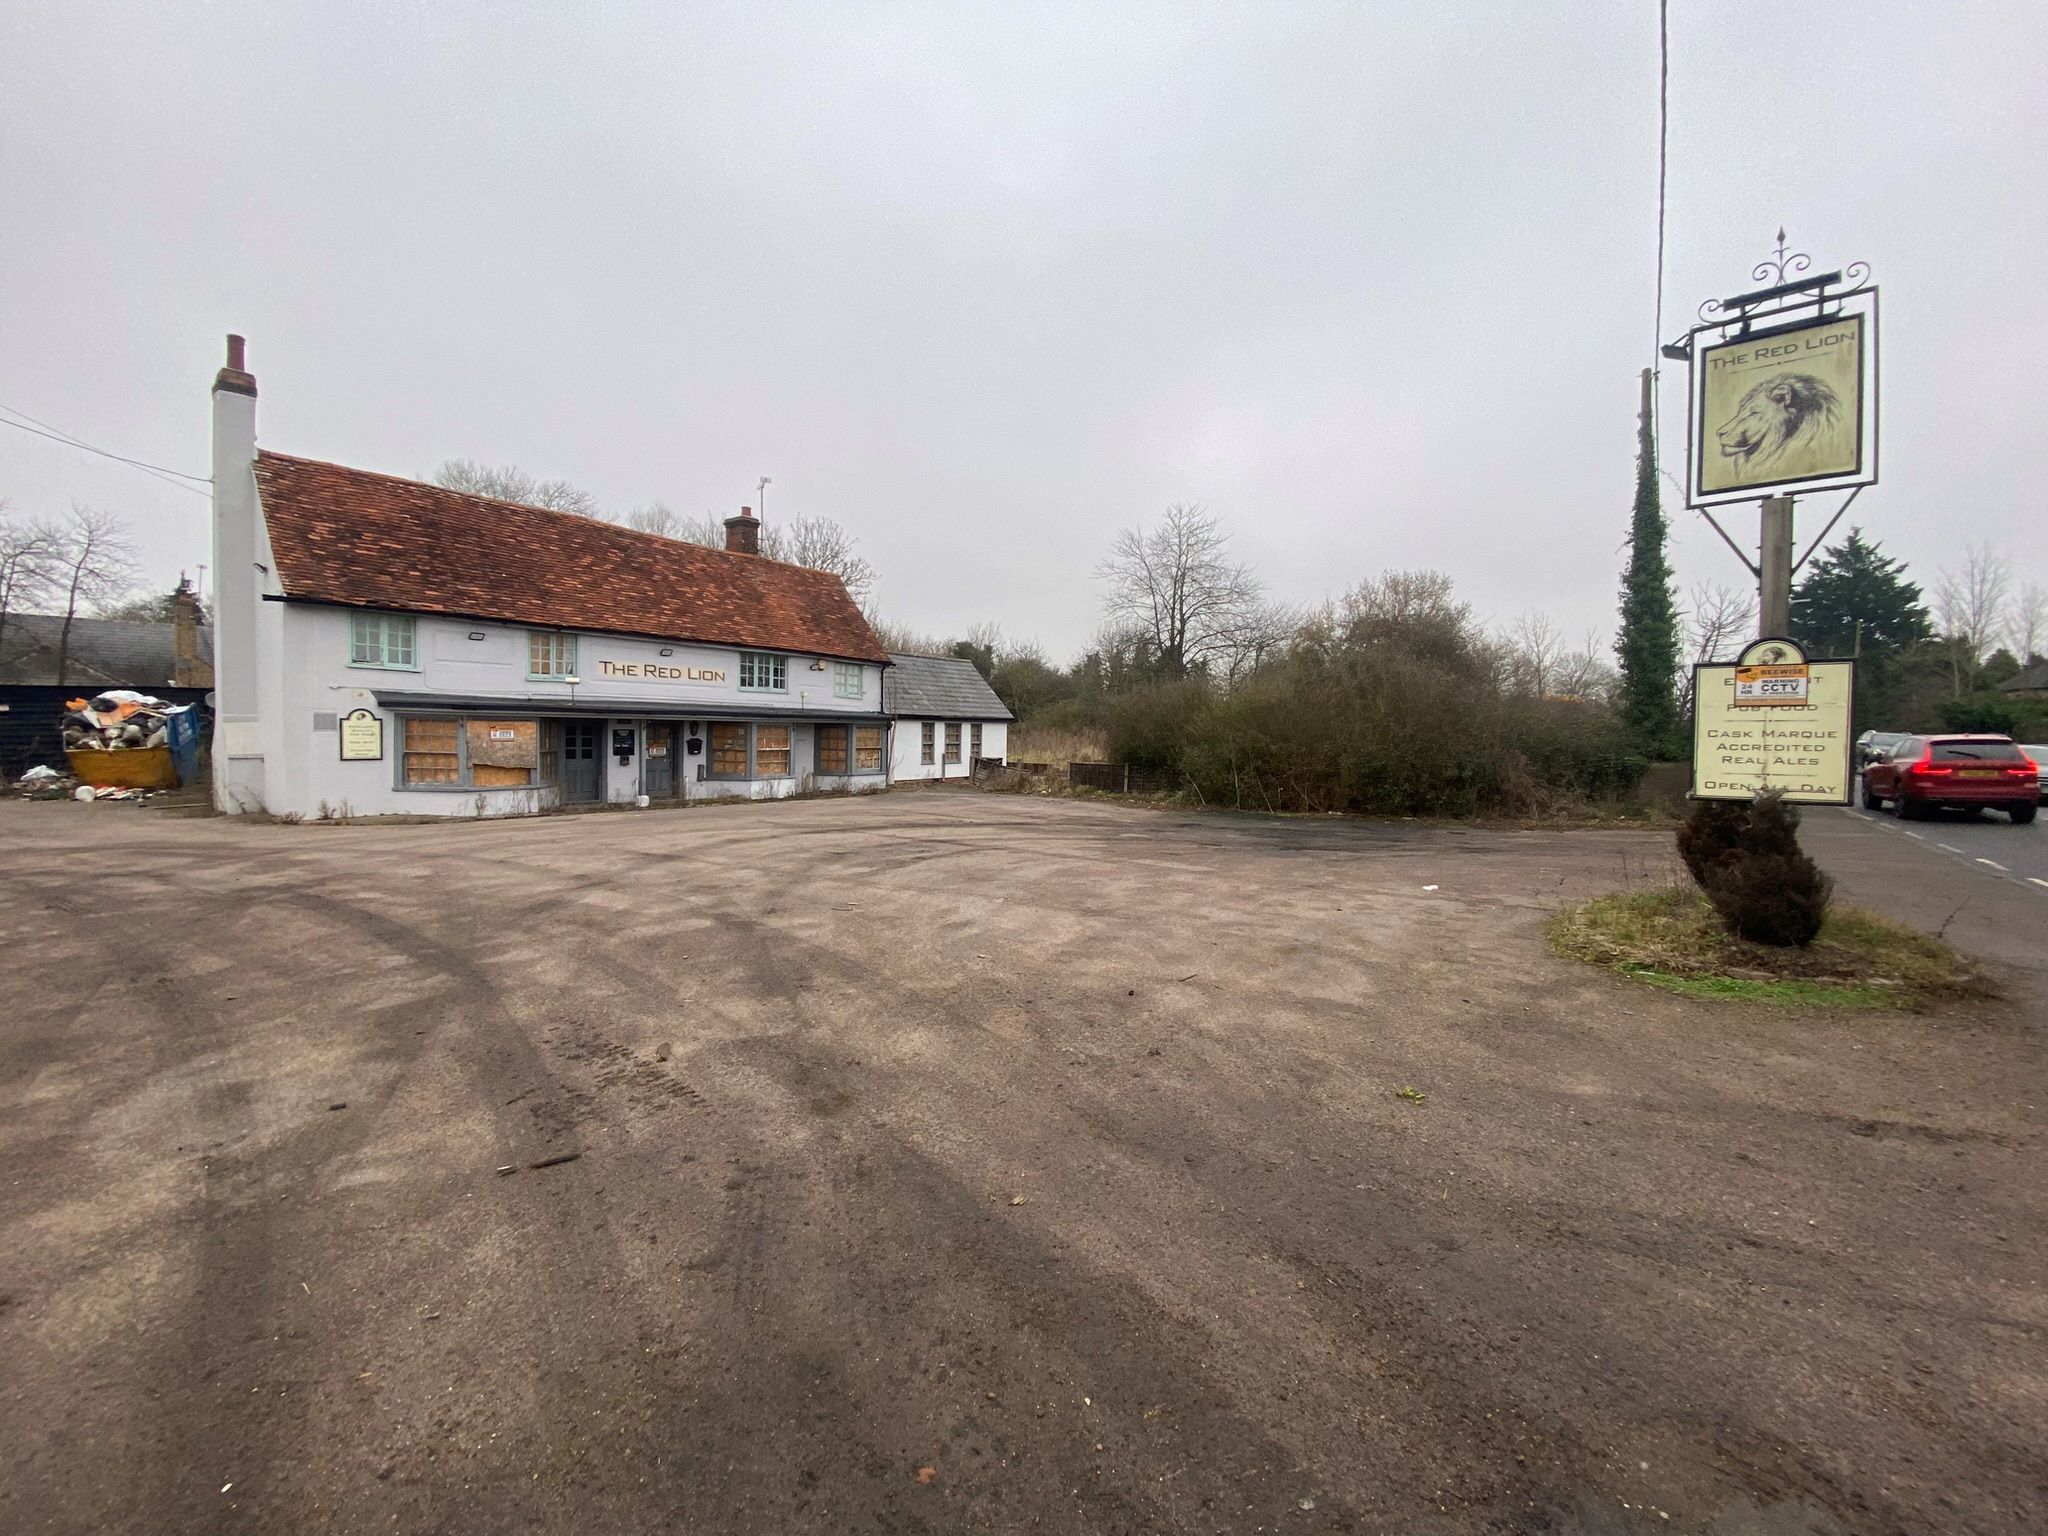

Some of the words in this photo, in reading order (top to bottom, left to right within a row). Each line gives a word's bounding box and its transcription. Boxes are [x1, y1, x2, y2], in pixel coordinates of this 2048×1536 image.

[1709, 353, 1748, 370] THE
[1754, 343, 1798, 360] RED
[1806, 331, 1855, 350] LION
[598, 660, 638, 676] THE
[643, 664, 682, 679] RED
[687, 667, 726, 682] LION
[1760, 684, 1799, 692] CCTV
[1707, 729, 1753, 738] CASK
[1761, 730, 1838, 739] MARQUE
[1716, 742, 1825, 752] ACCREDITED
[1721, 756, 1766, 764] REAL
[1773, 757, 1819, 766] ALES
[1704, 781, 1751, 791] OPEN
[1801, 784, 1836, 794] DAY
